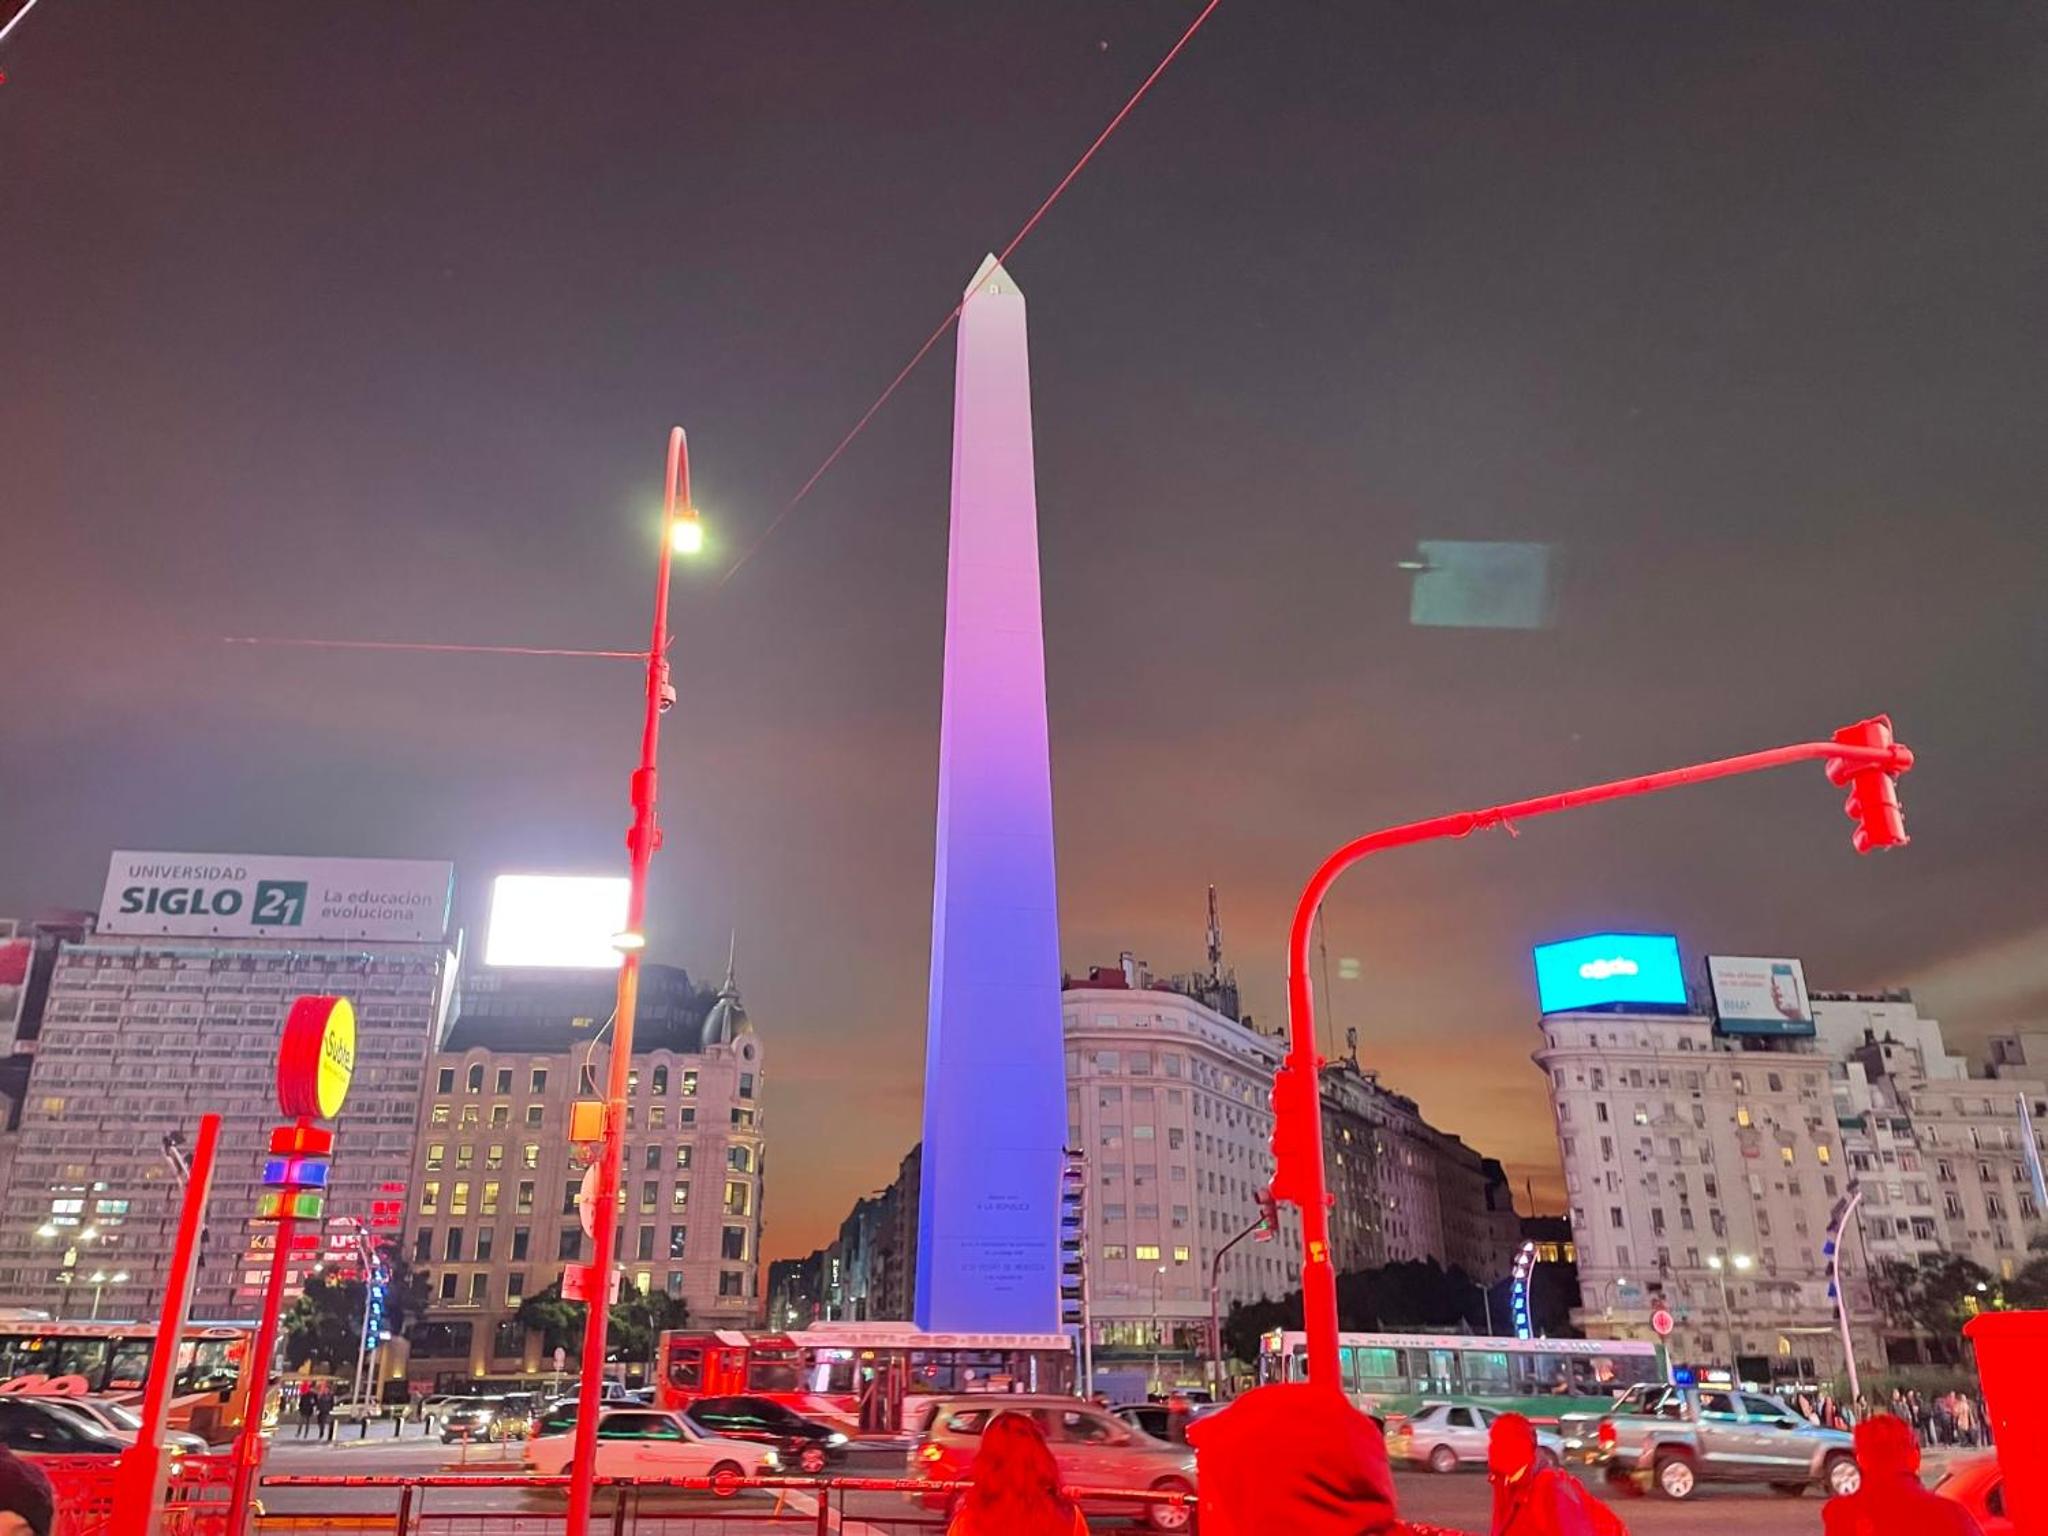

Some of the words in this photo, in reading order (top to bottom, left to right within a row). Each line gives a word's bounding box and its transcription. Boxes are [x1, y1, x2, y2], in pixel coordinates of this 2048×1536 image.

[129, 865, 247, 880] UNIVERSIDAD
[324, 890, 342, 903] La
[119, 886, 243, 916] SIGLO
[259, 888, 299, 925] 21
[321, 905, 414, 920] evoluciona
